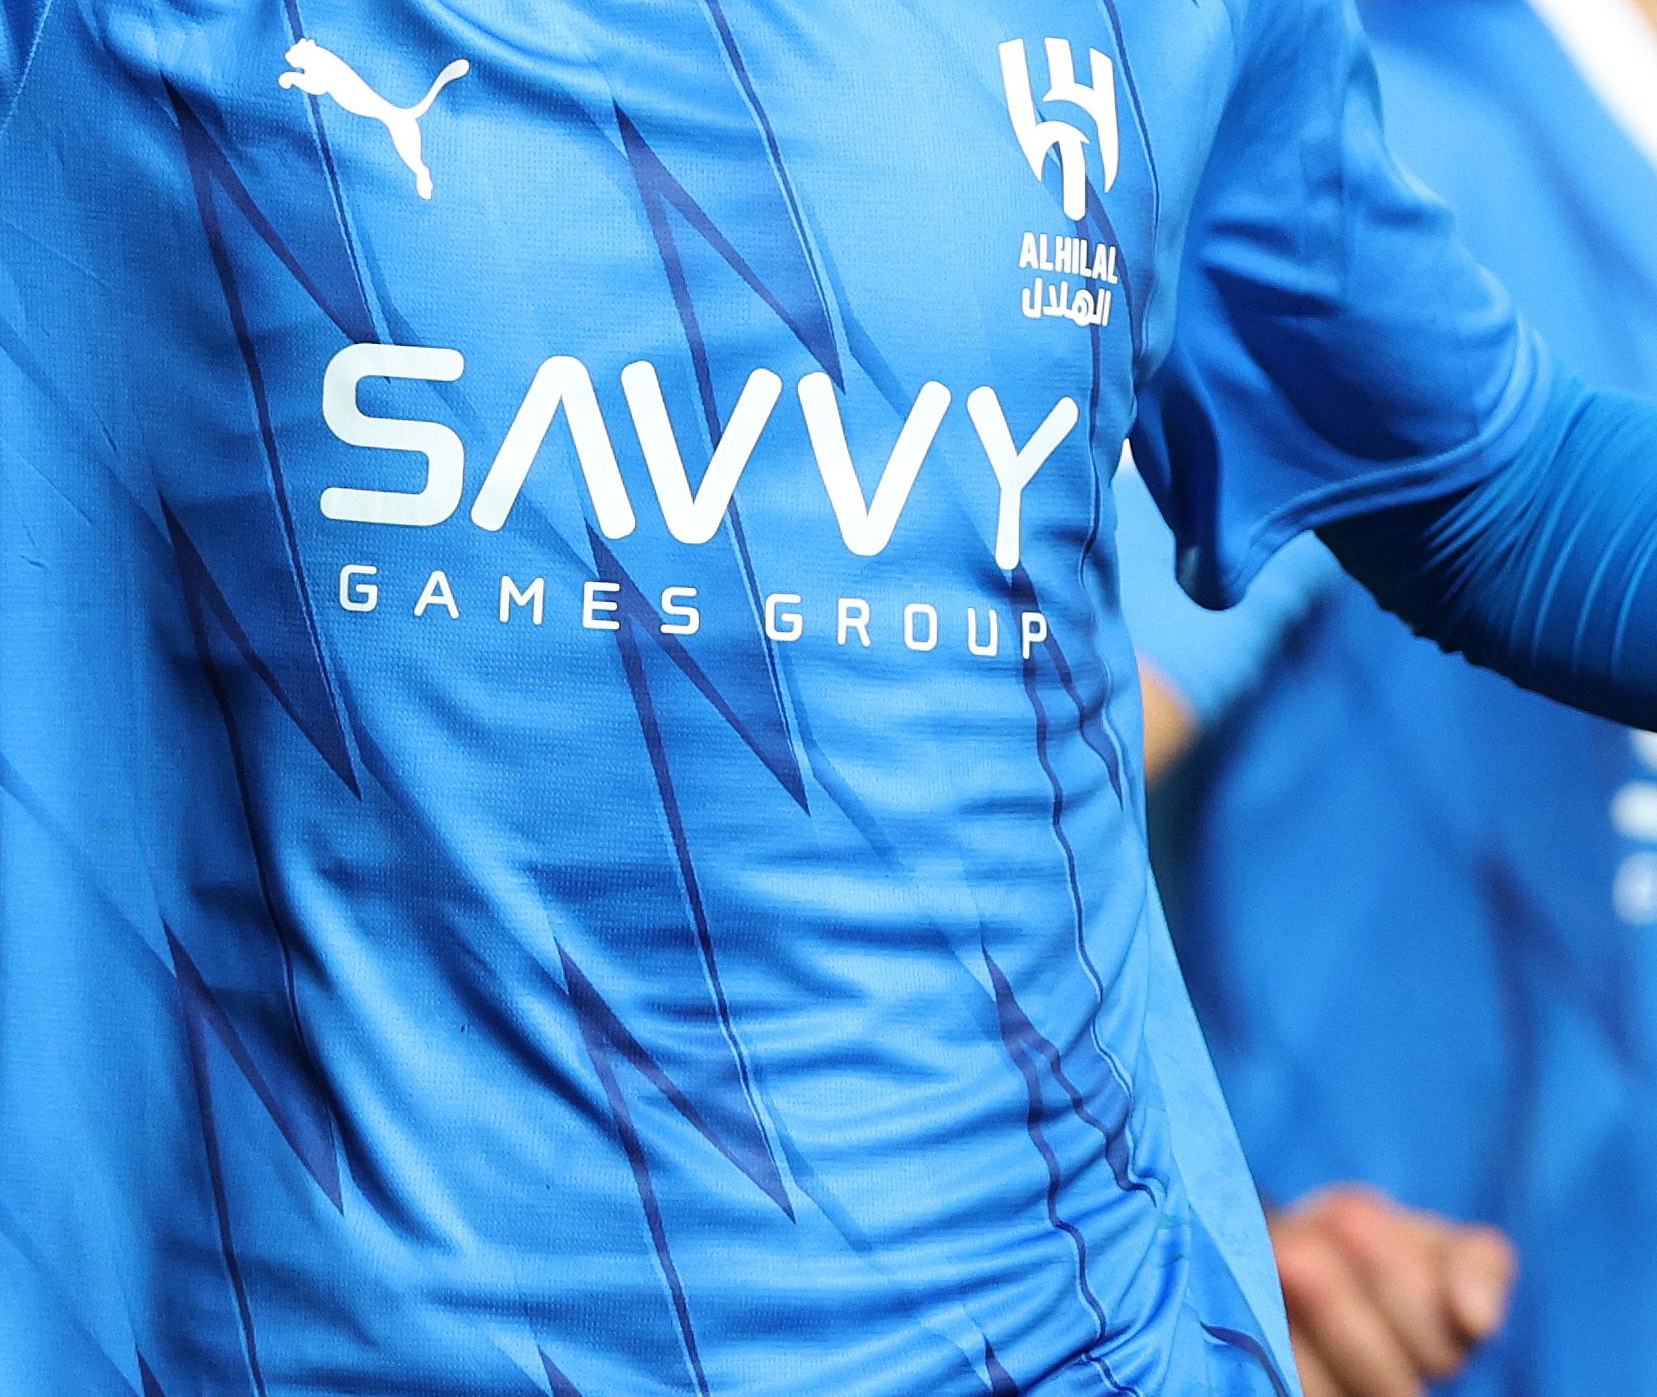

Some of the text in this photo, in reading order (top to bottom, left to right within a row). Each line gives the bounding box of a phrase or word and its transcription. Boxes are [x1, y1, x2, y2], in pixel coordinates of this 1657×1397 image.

[1021, 277, 1112, 327] الهلال
[320, 342, 1080, 571] SAVVY
[339, 564, 1048, 660] GAMES GROUP
